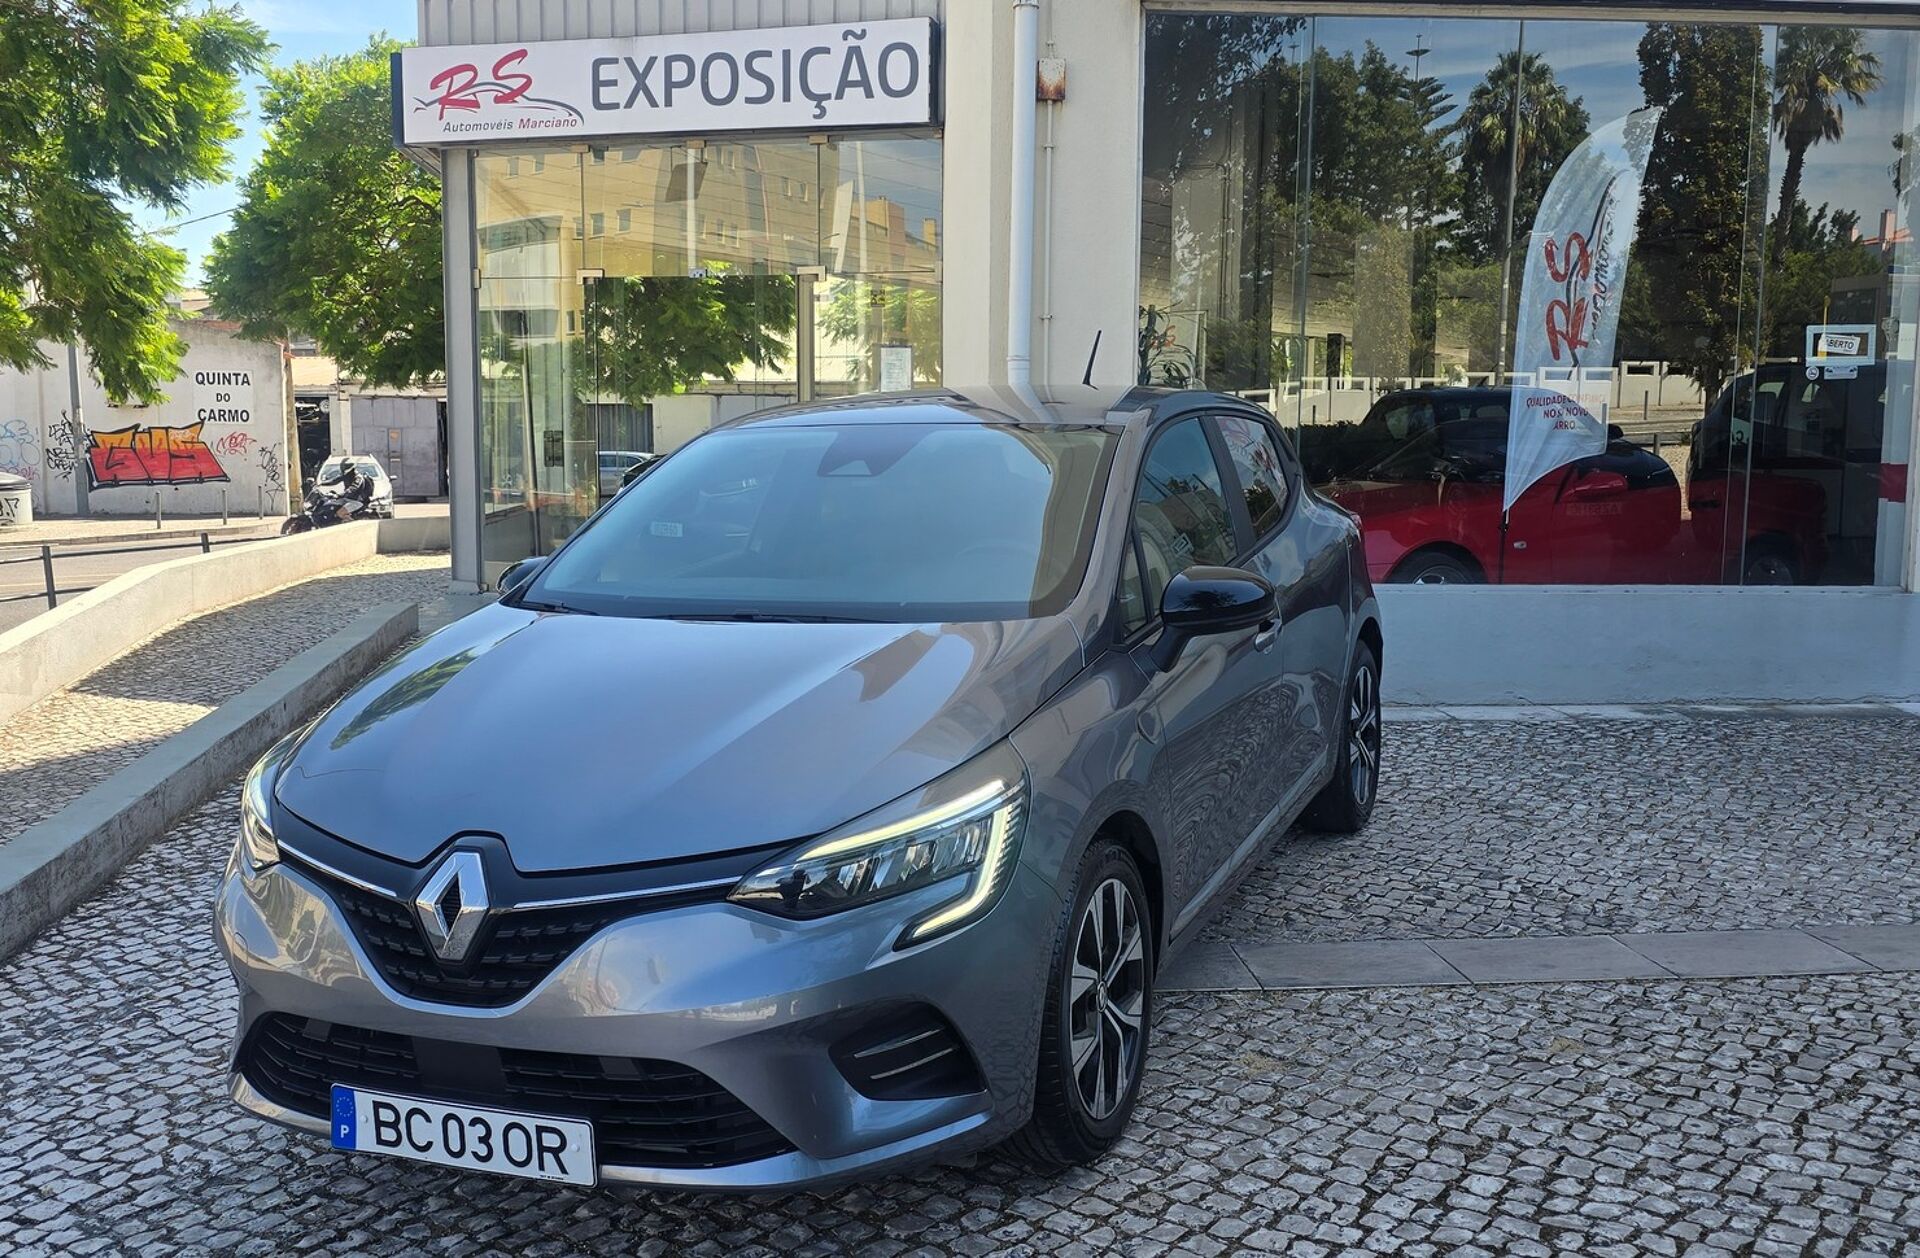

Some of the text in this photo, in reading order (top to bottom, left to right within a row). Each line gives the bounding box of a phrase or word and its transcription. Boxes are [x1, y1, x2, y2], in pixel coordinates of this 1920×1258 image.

[592, 28, 920, 119] EXPOSIÇÃO
[430, 49, 532, 121] RS
[518, 116, 578, 131] Marciano
[195, 372, 251, 386] QUINTA
[216, 393, 231, 402] DO
[197, 408, 250, 422] CARMO
[340, 1124, 350, 1138] P
[372, 1100, 569, 1175] BC 03 OR
